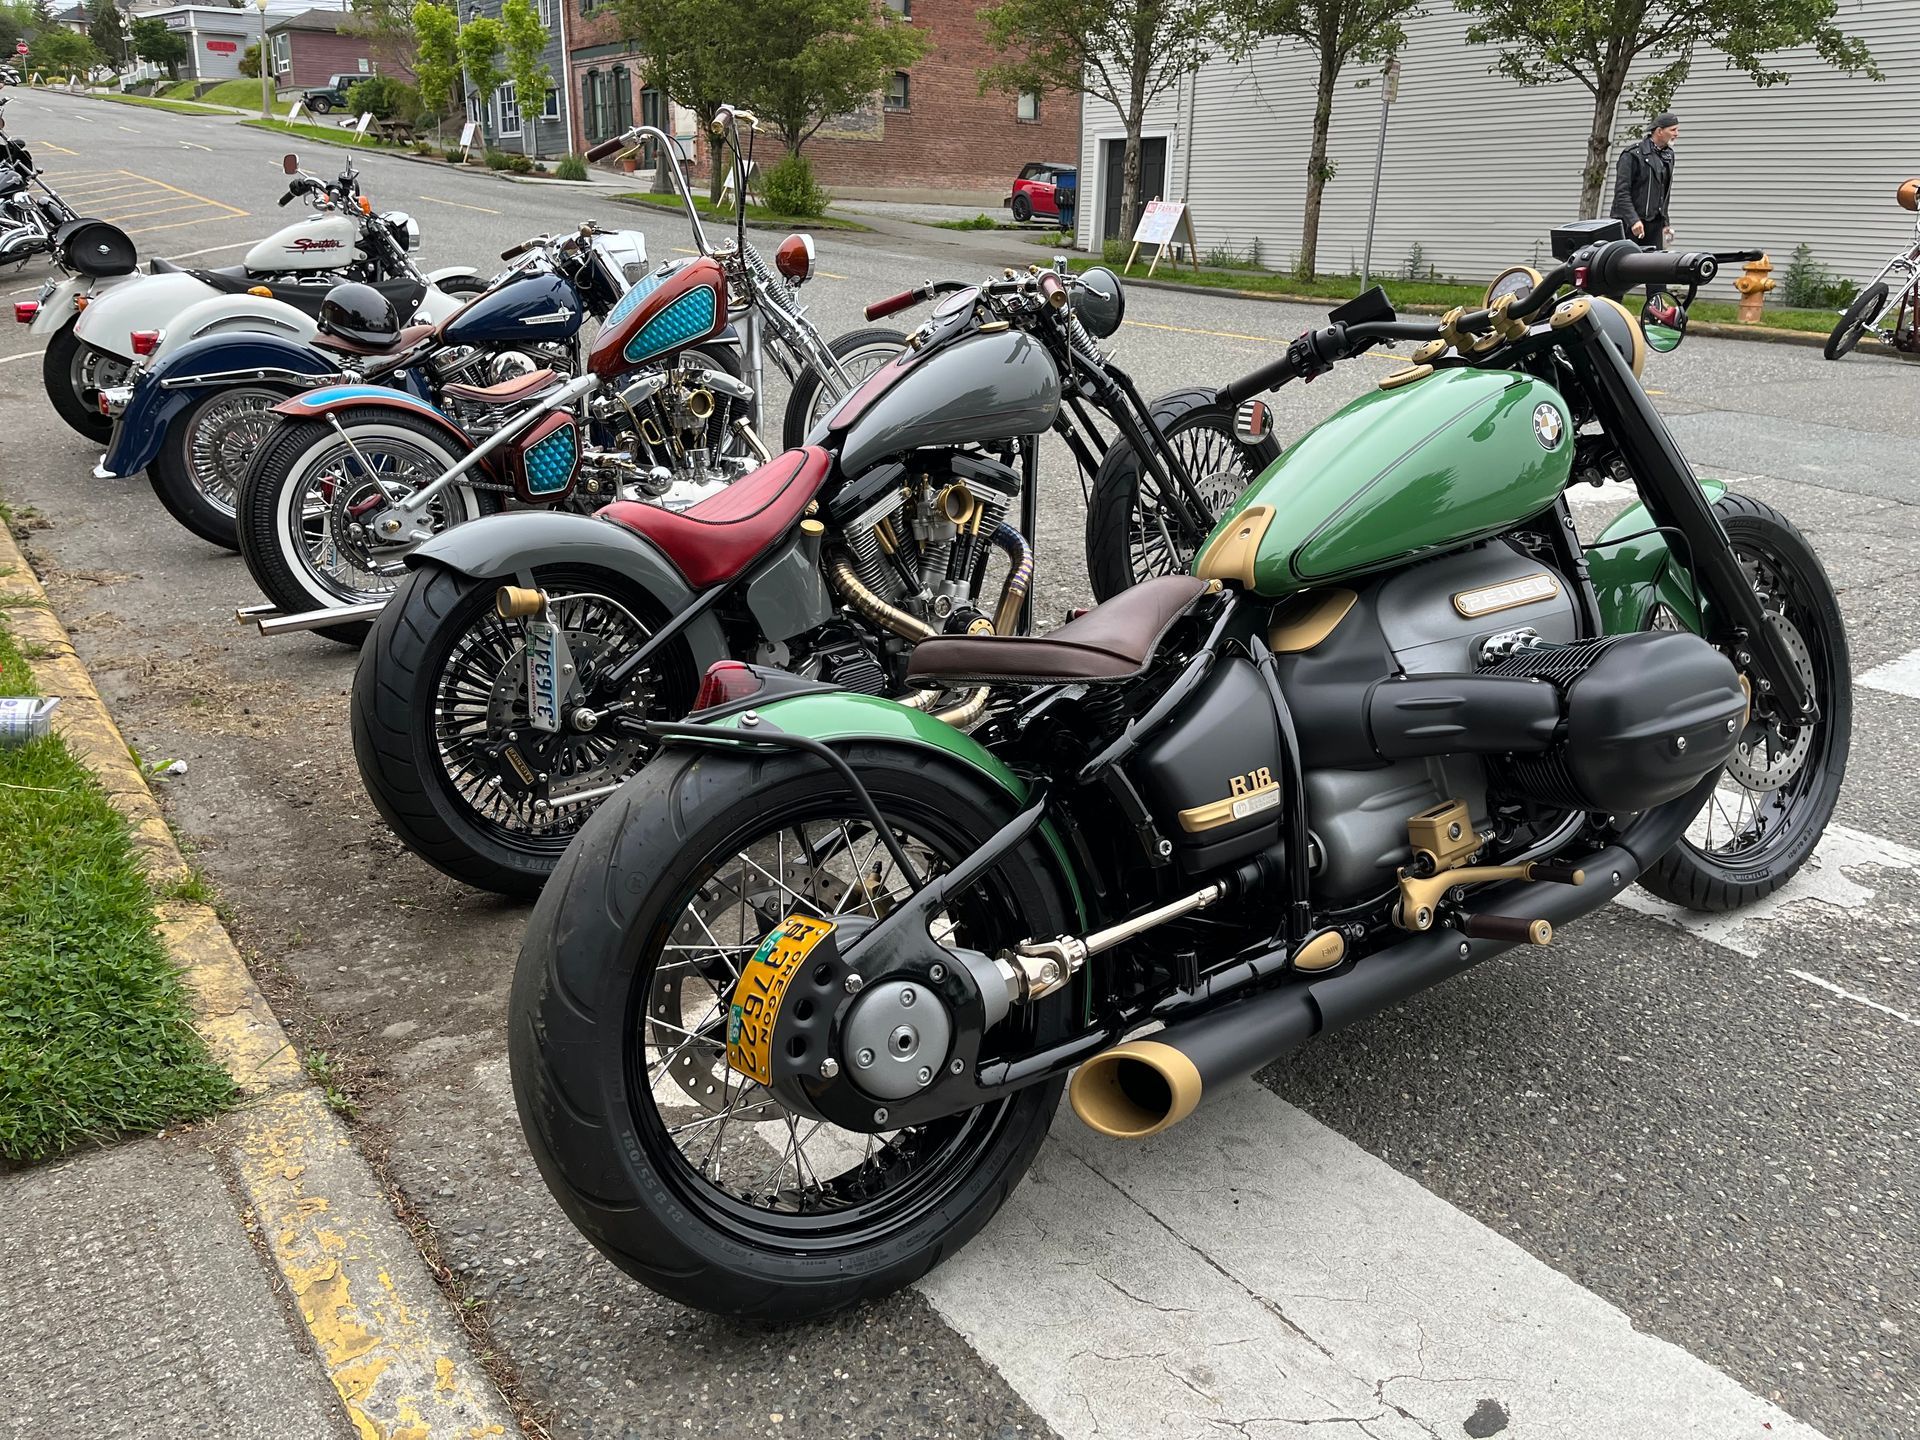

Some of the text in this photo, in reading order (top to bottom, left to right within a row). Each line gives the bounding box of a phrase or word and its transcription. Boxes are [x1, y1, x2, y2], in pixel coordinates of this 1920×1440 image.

[535, 635, 554, 719] 3J6347
[1735, 867, 1769, 881] MICHELIN
[738, 947, 789, 1073] 37622
[761, 951, 801, 1044] OREGON
